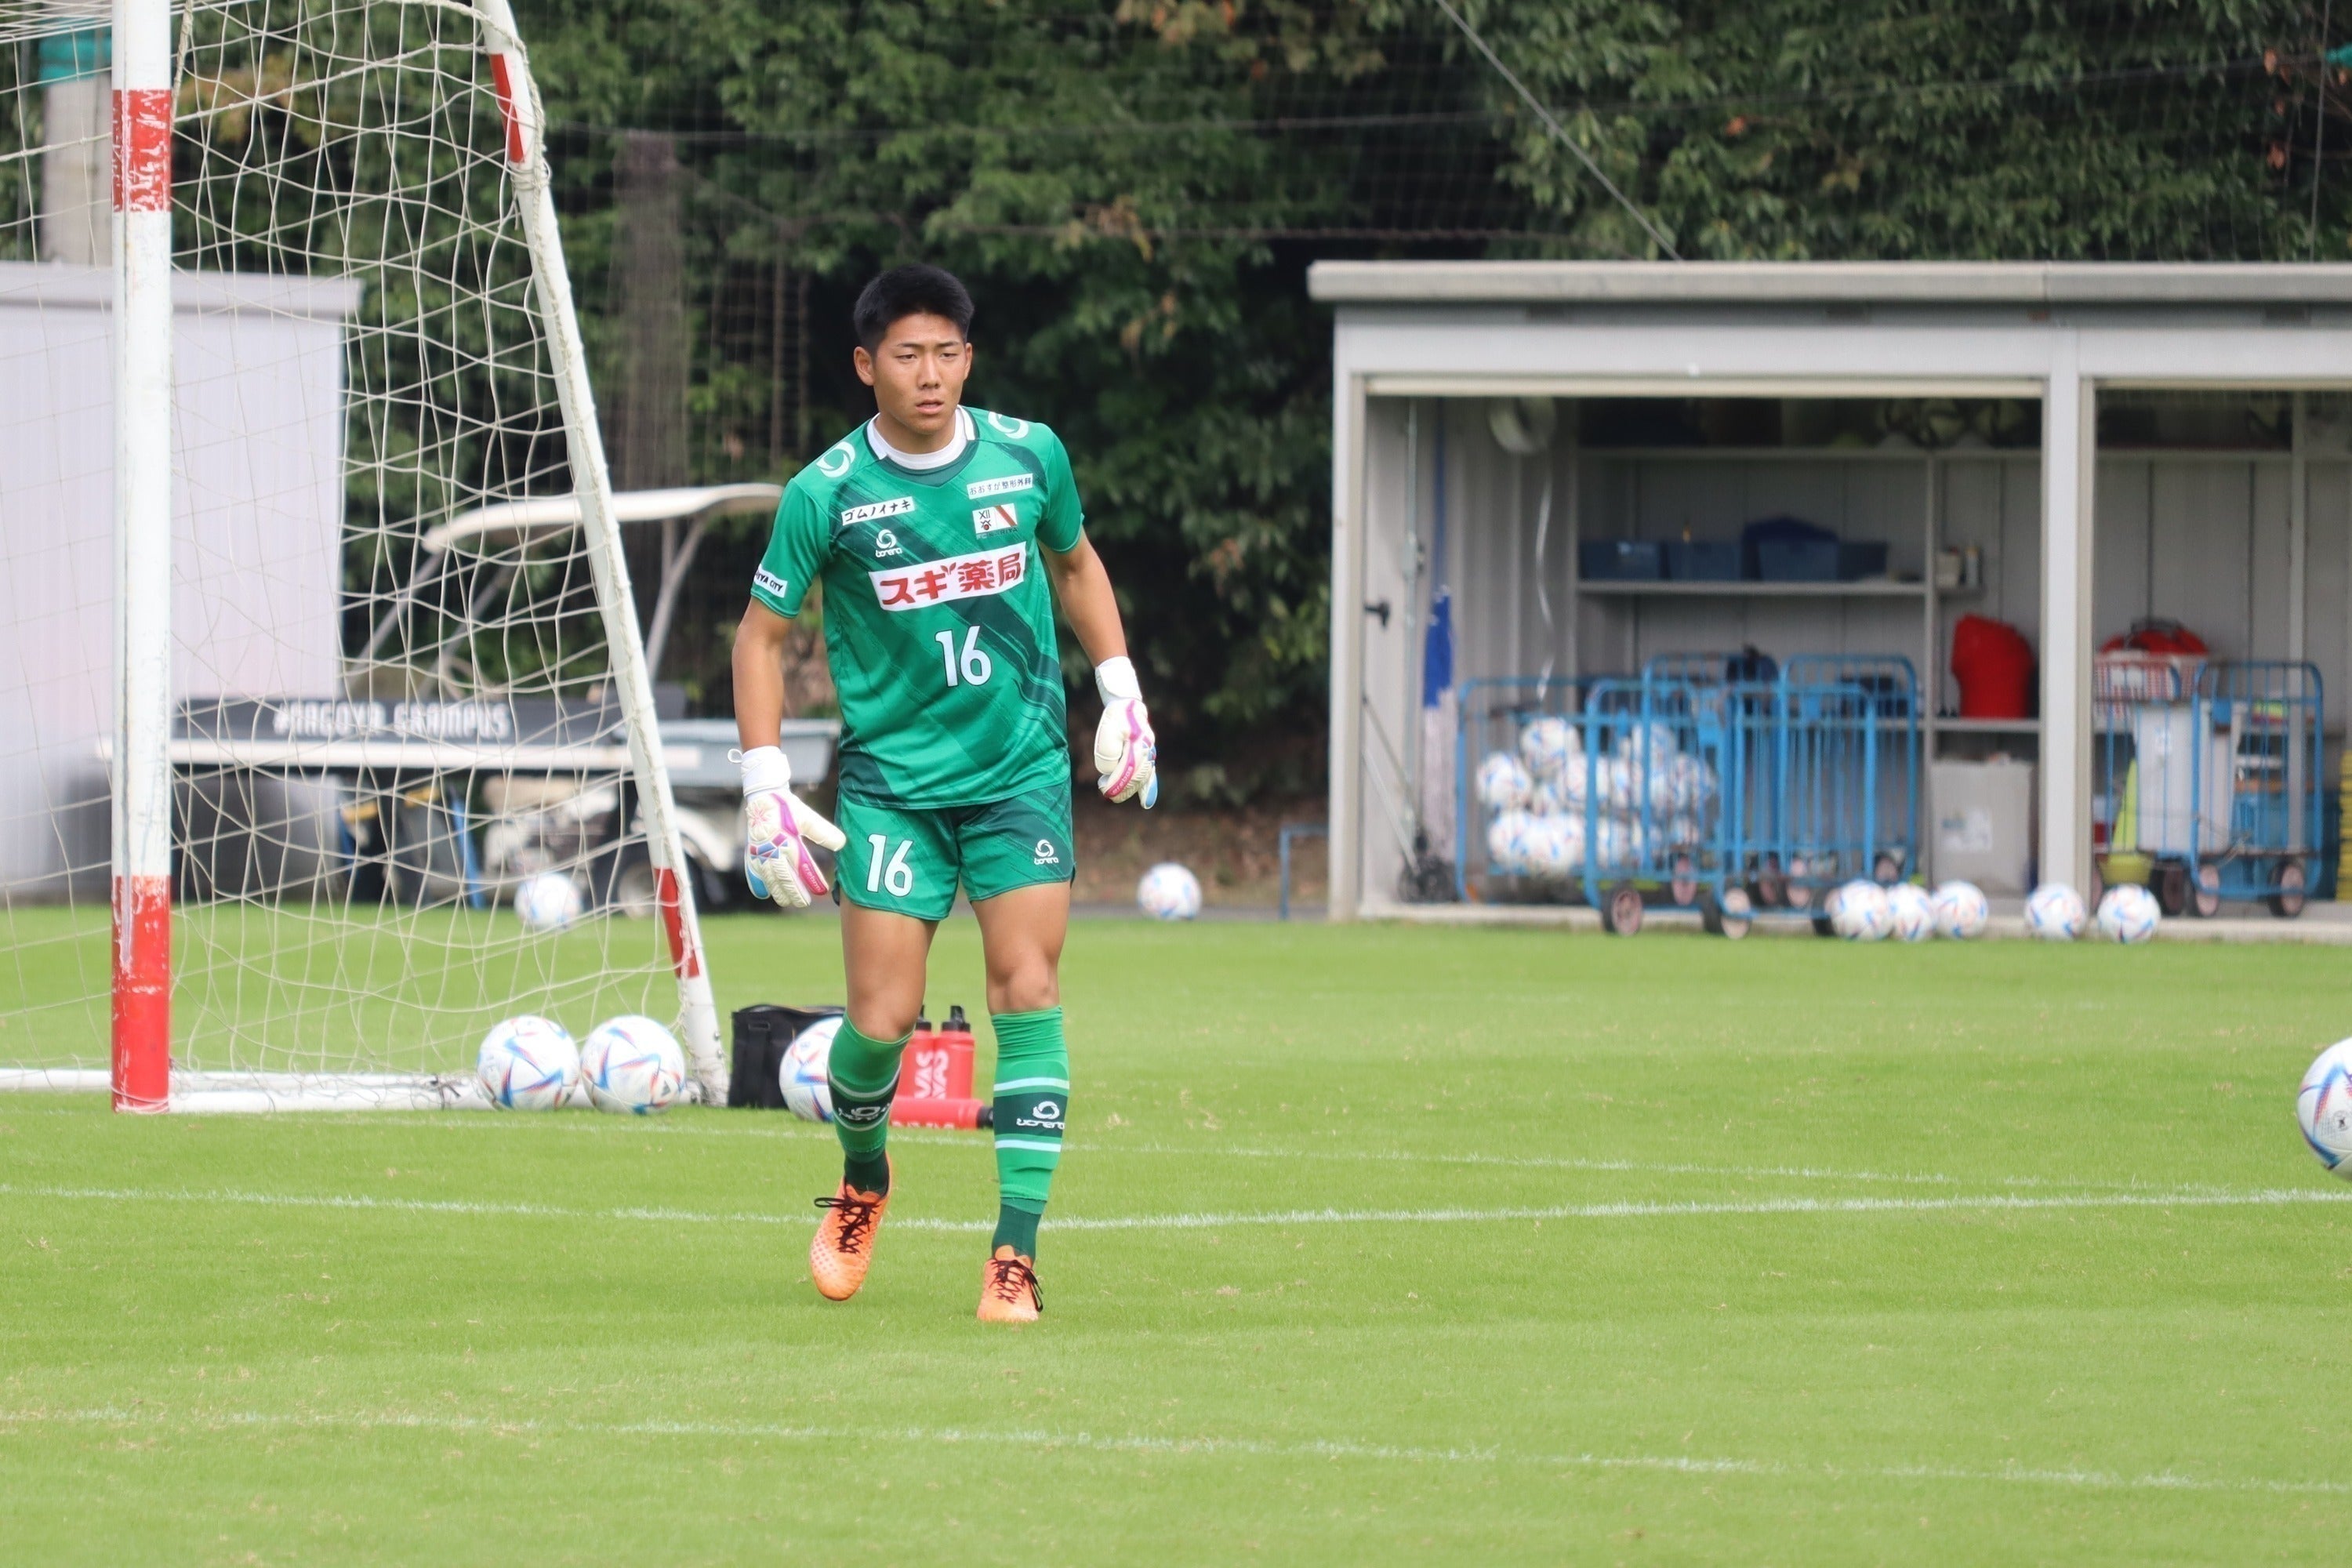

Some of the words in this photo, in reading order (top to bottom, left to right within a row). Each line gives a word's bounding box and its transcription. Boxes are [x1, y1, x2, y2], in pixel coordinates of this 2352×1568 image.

[845, 499, 911, 522] ゴムノイナキ
[769, 579, 783, 592] CITY
[880, 552, 1022, 605] スギ薬局
[934, 625, 993, 688] 16
[866, 833, 914, 898] 16
